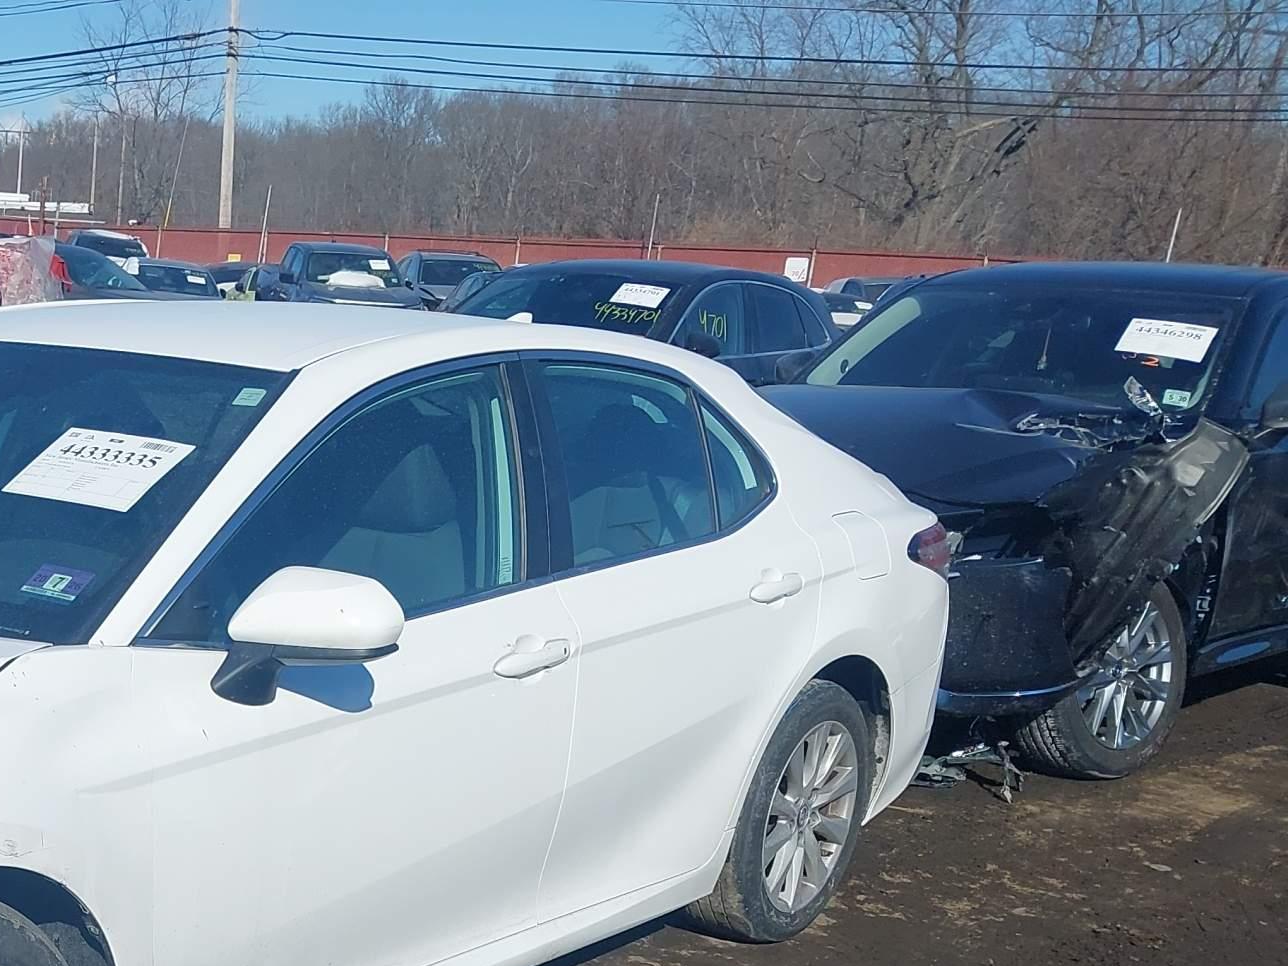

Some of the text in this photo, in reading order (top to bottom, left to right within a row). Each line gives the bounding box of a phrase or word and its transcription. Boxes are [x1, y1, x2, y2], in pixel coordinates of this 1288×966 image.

[698, 308, 728, 343] 4701
[1135, 325, 1203, 341] 44346298
[59, 443, 164, 469] 44333335
[52, 576, 66, 589] 7
